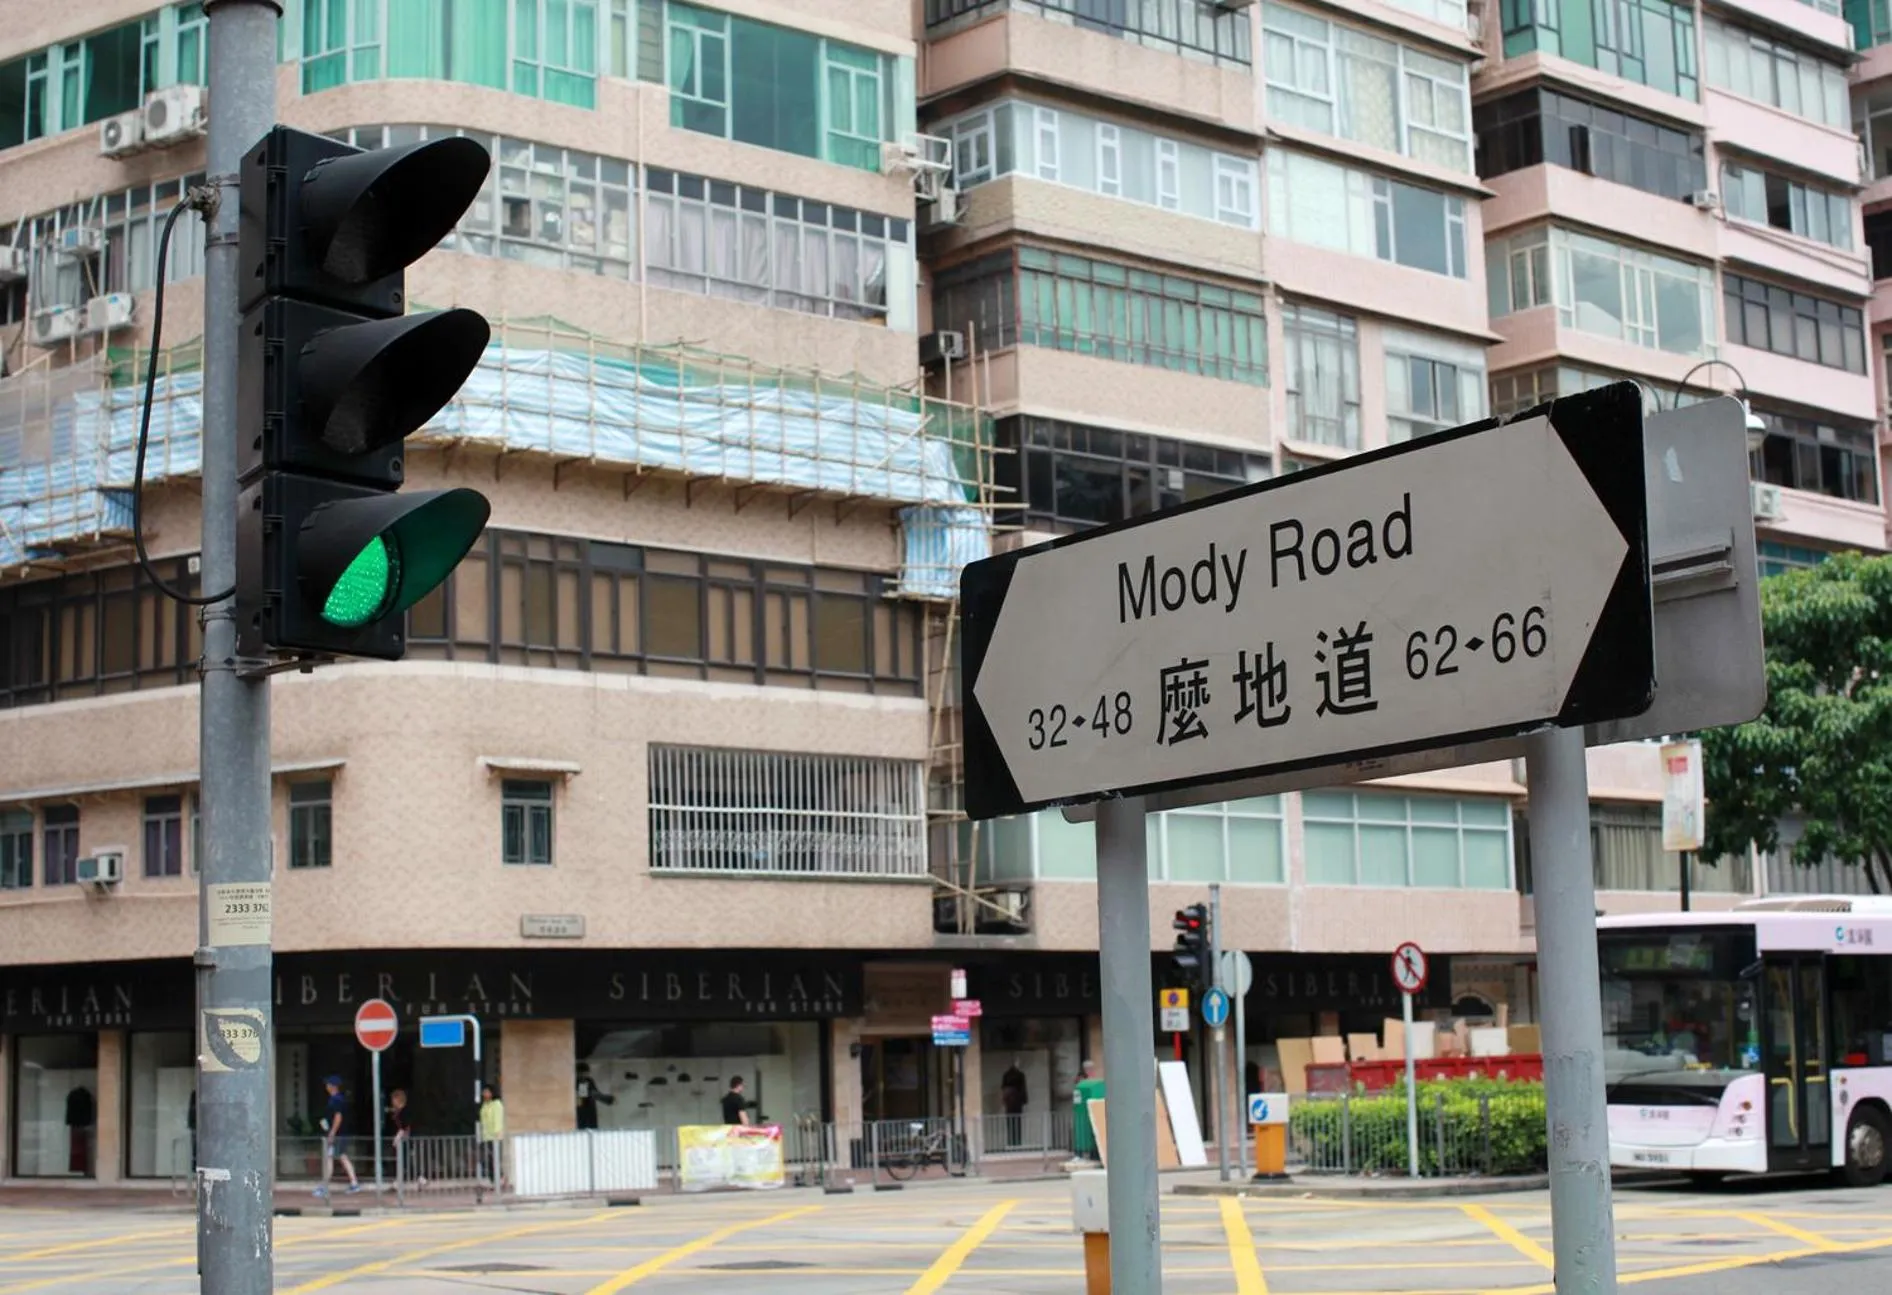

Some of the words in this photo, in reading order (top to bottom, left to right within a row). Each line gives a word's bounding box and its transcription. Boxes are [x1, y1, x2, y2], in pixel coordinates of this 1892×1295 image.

[1118, 542, 1247, 623] Mody
[1269, 492, 1413, 588] Road
[1157, 620, 1379, 748] 麼地道
[609, 970, 843, 1001] SIBERIAN
